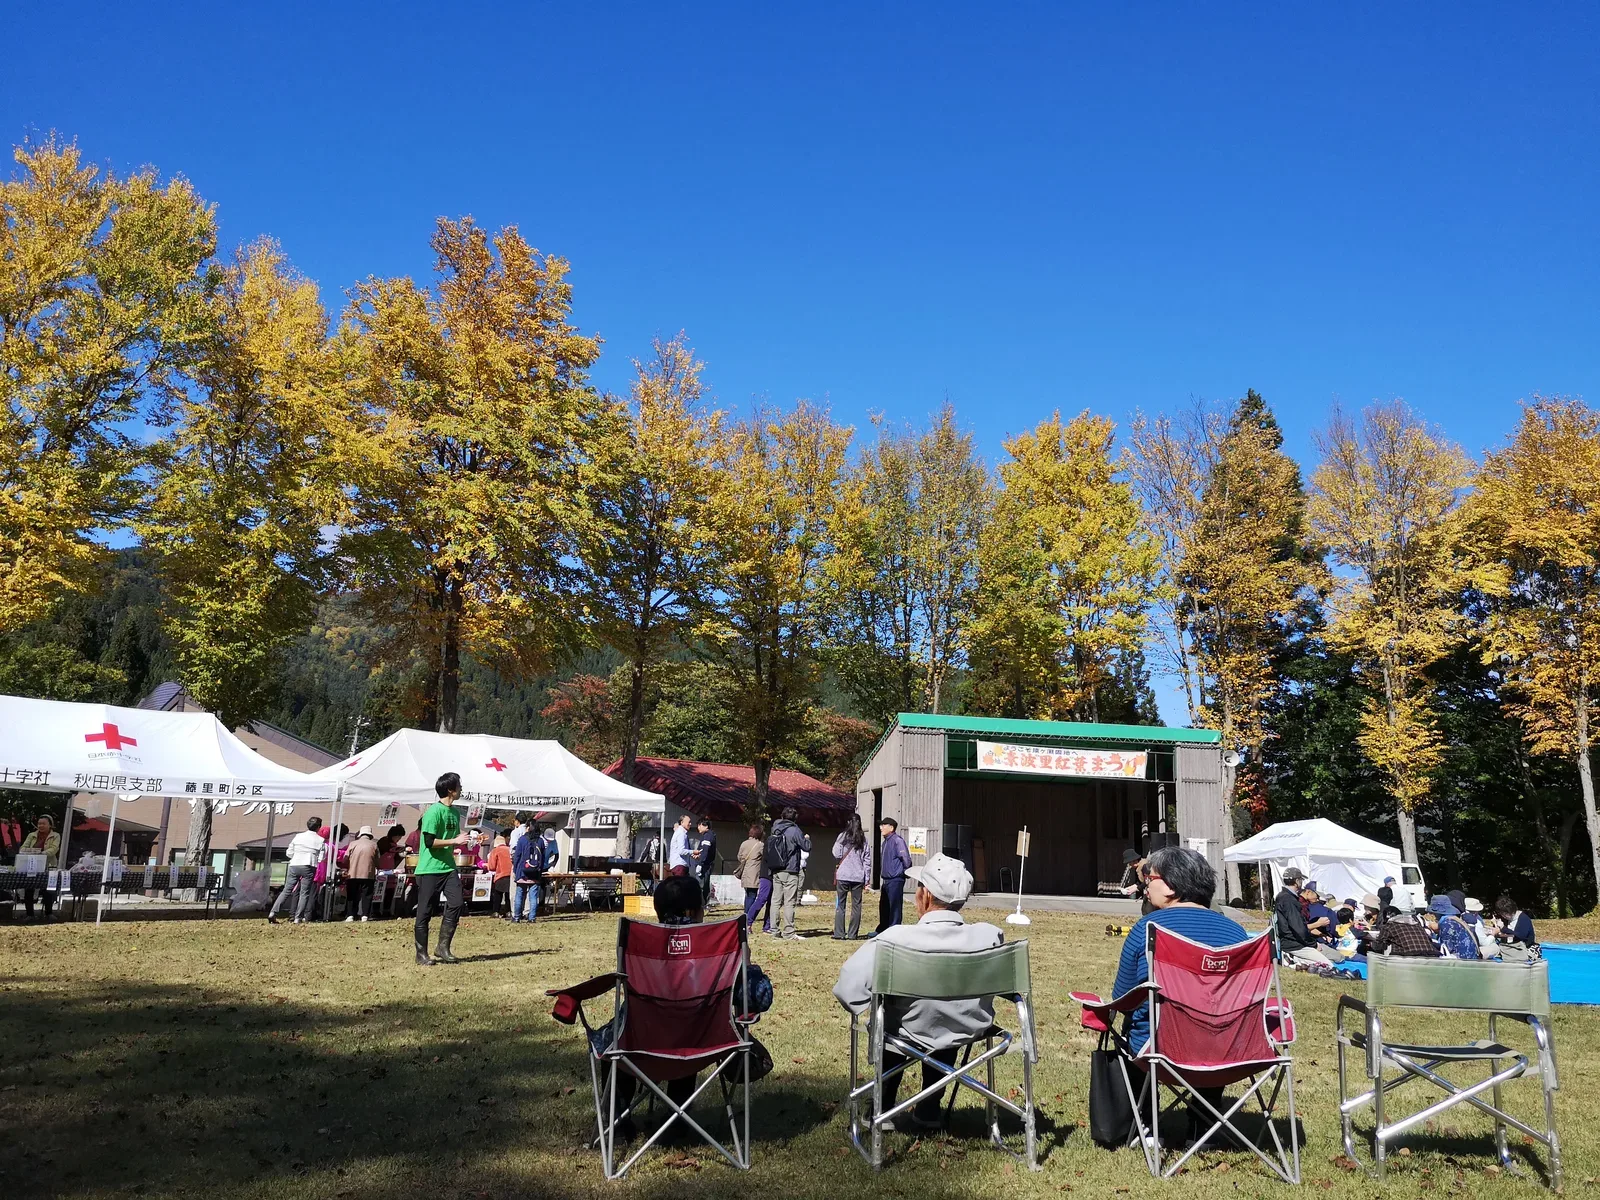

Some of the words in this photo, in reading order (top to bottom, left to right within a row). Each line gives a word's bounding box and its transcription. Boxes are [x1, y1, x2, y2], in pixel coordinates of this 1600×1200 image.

[74, 773, 163, 793] 秋田県支部
[185, 781, 264, 796] 藤里町分区
